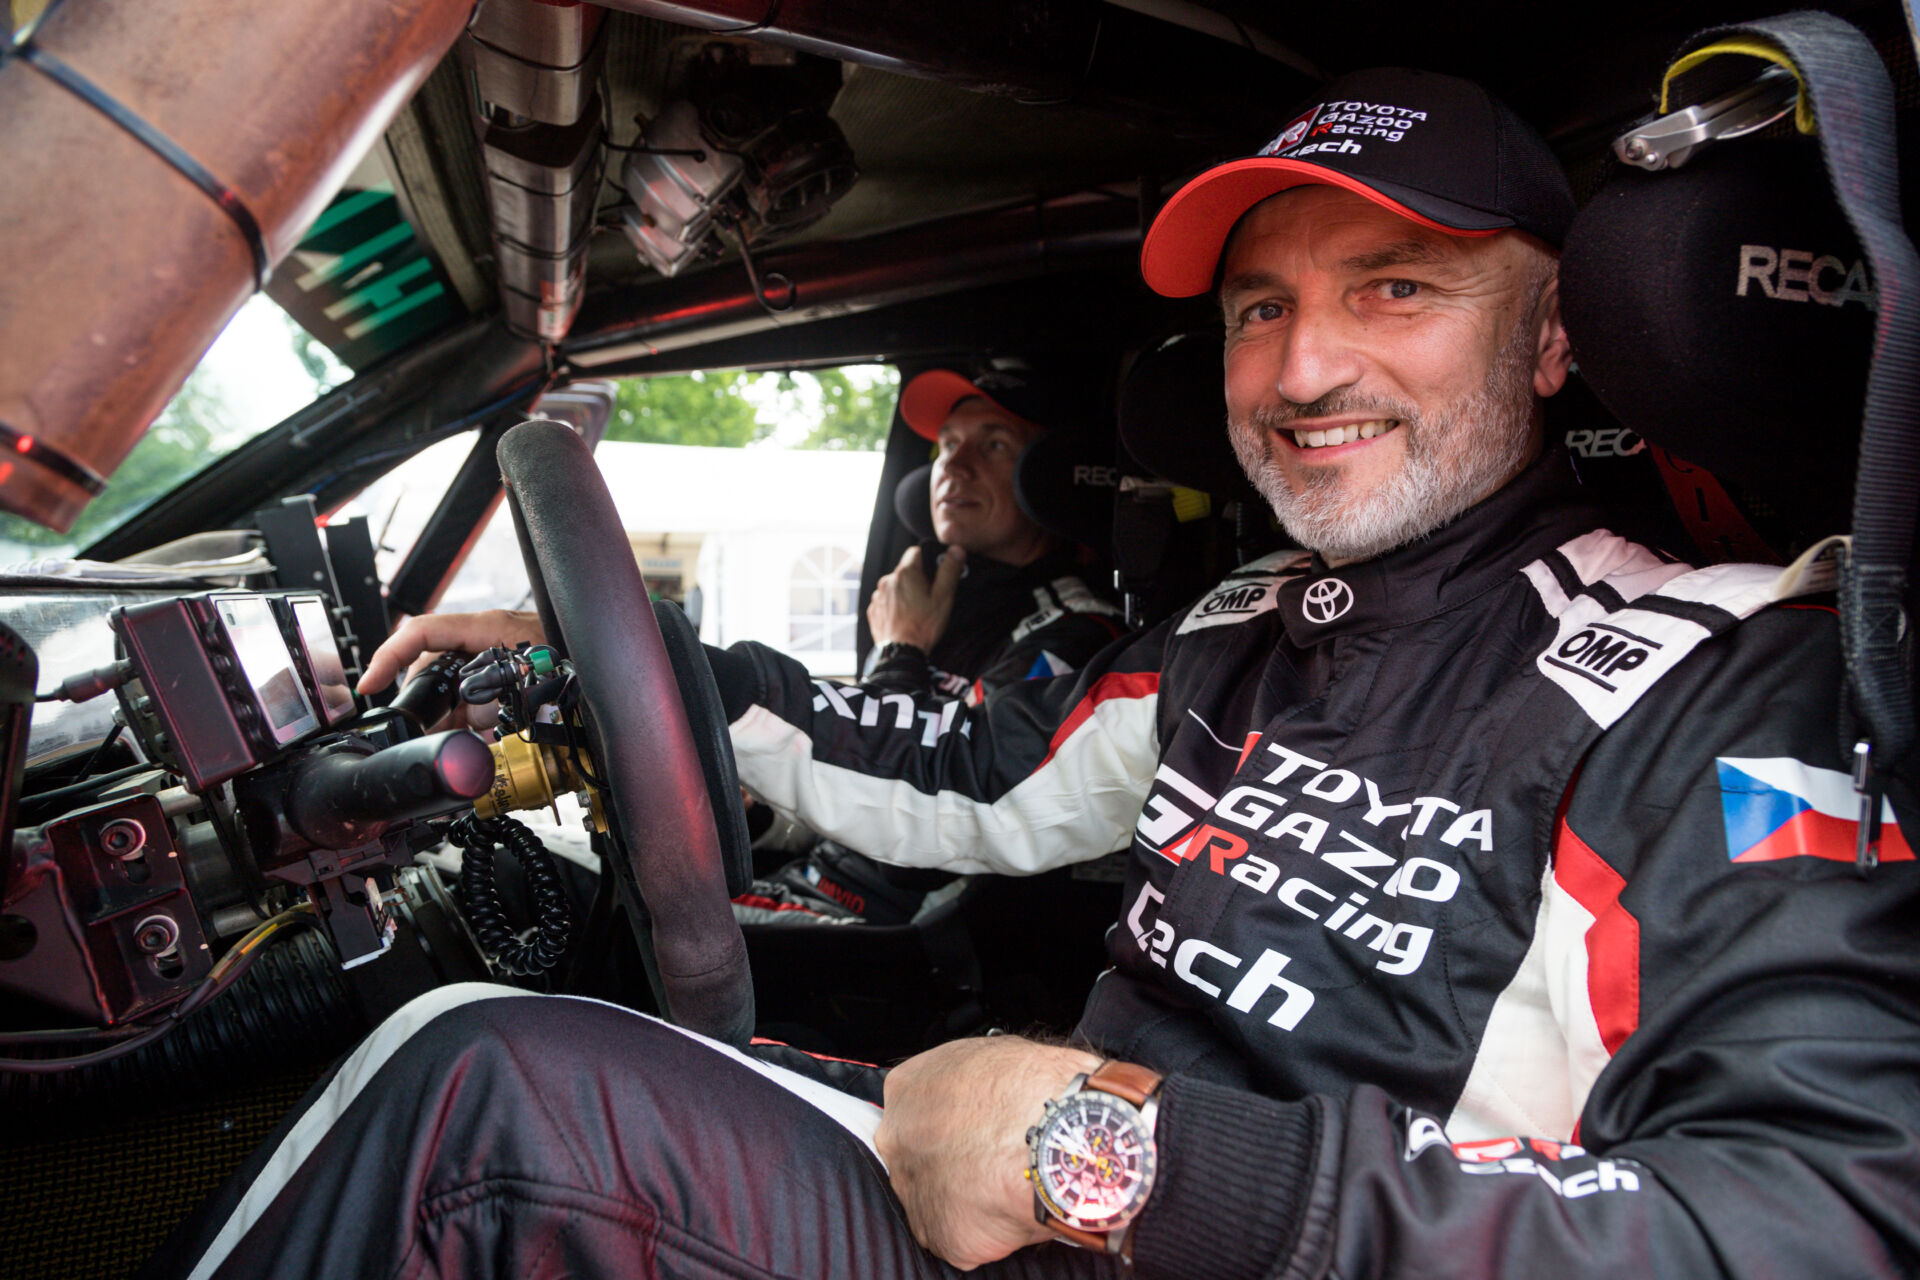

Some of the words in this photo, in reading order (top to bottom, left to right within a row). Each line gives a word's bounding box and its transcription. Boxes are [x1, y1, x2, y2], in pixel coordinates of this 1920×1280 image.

[1318, 112, 1413, 130] GAZOO
[1327, 101, 1428, 121] TOYOTA
[1310, 122, 1405, 142] Racing
[1736, 244, 1874, 310] RECA
[1565, 428, 1647, 458] REC
[1074, 465, 1117, 487] REC
[1203, 588, 1267, 613] OMP
[1558, 630, 1649, 678] OMP
[1262, 742, 1494, 851] TOYTA
[1214, 786, 1461, 902] GAZO
[1183, 824, 1434, 976] Racing
